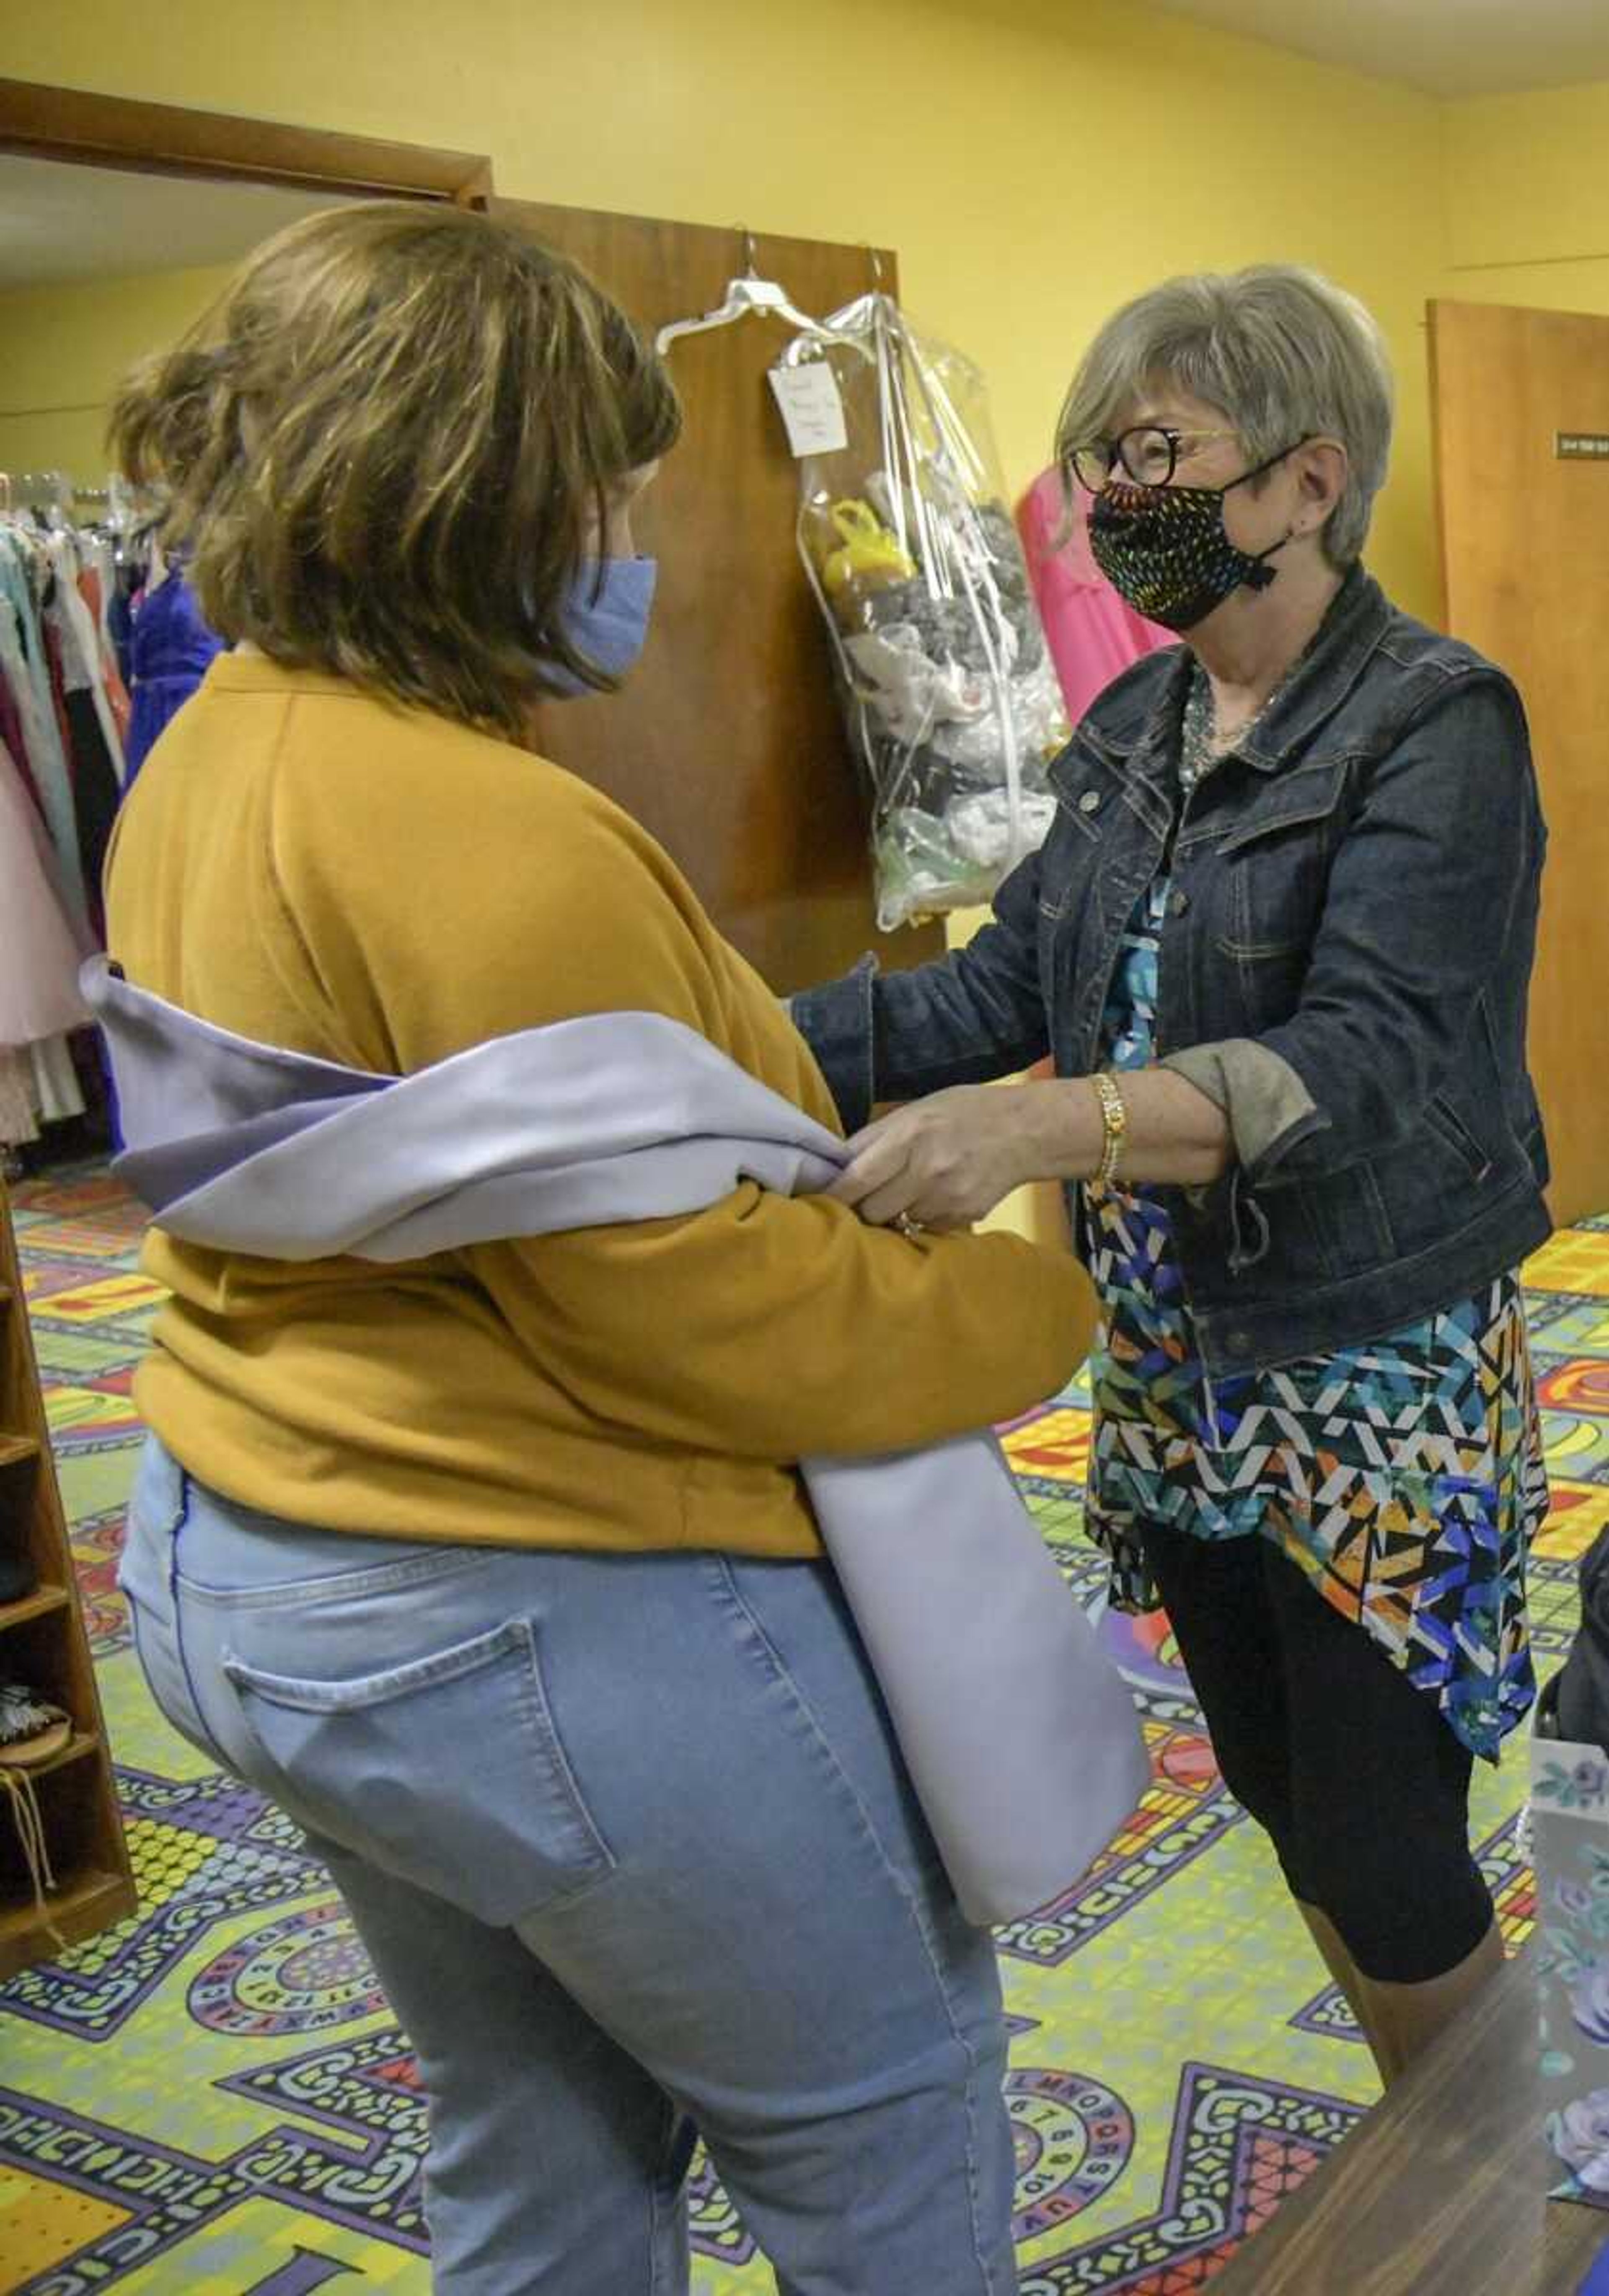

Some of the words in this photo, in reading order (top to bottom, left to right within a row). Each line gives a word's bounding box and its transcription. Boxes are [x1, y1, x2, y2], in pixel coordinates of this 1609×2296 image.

[1079, 2095, 1101, 2108] O
[1087, 2163, 1110, 2174] S
[1074, 2183, 1098, 2195] T
